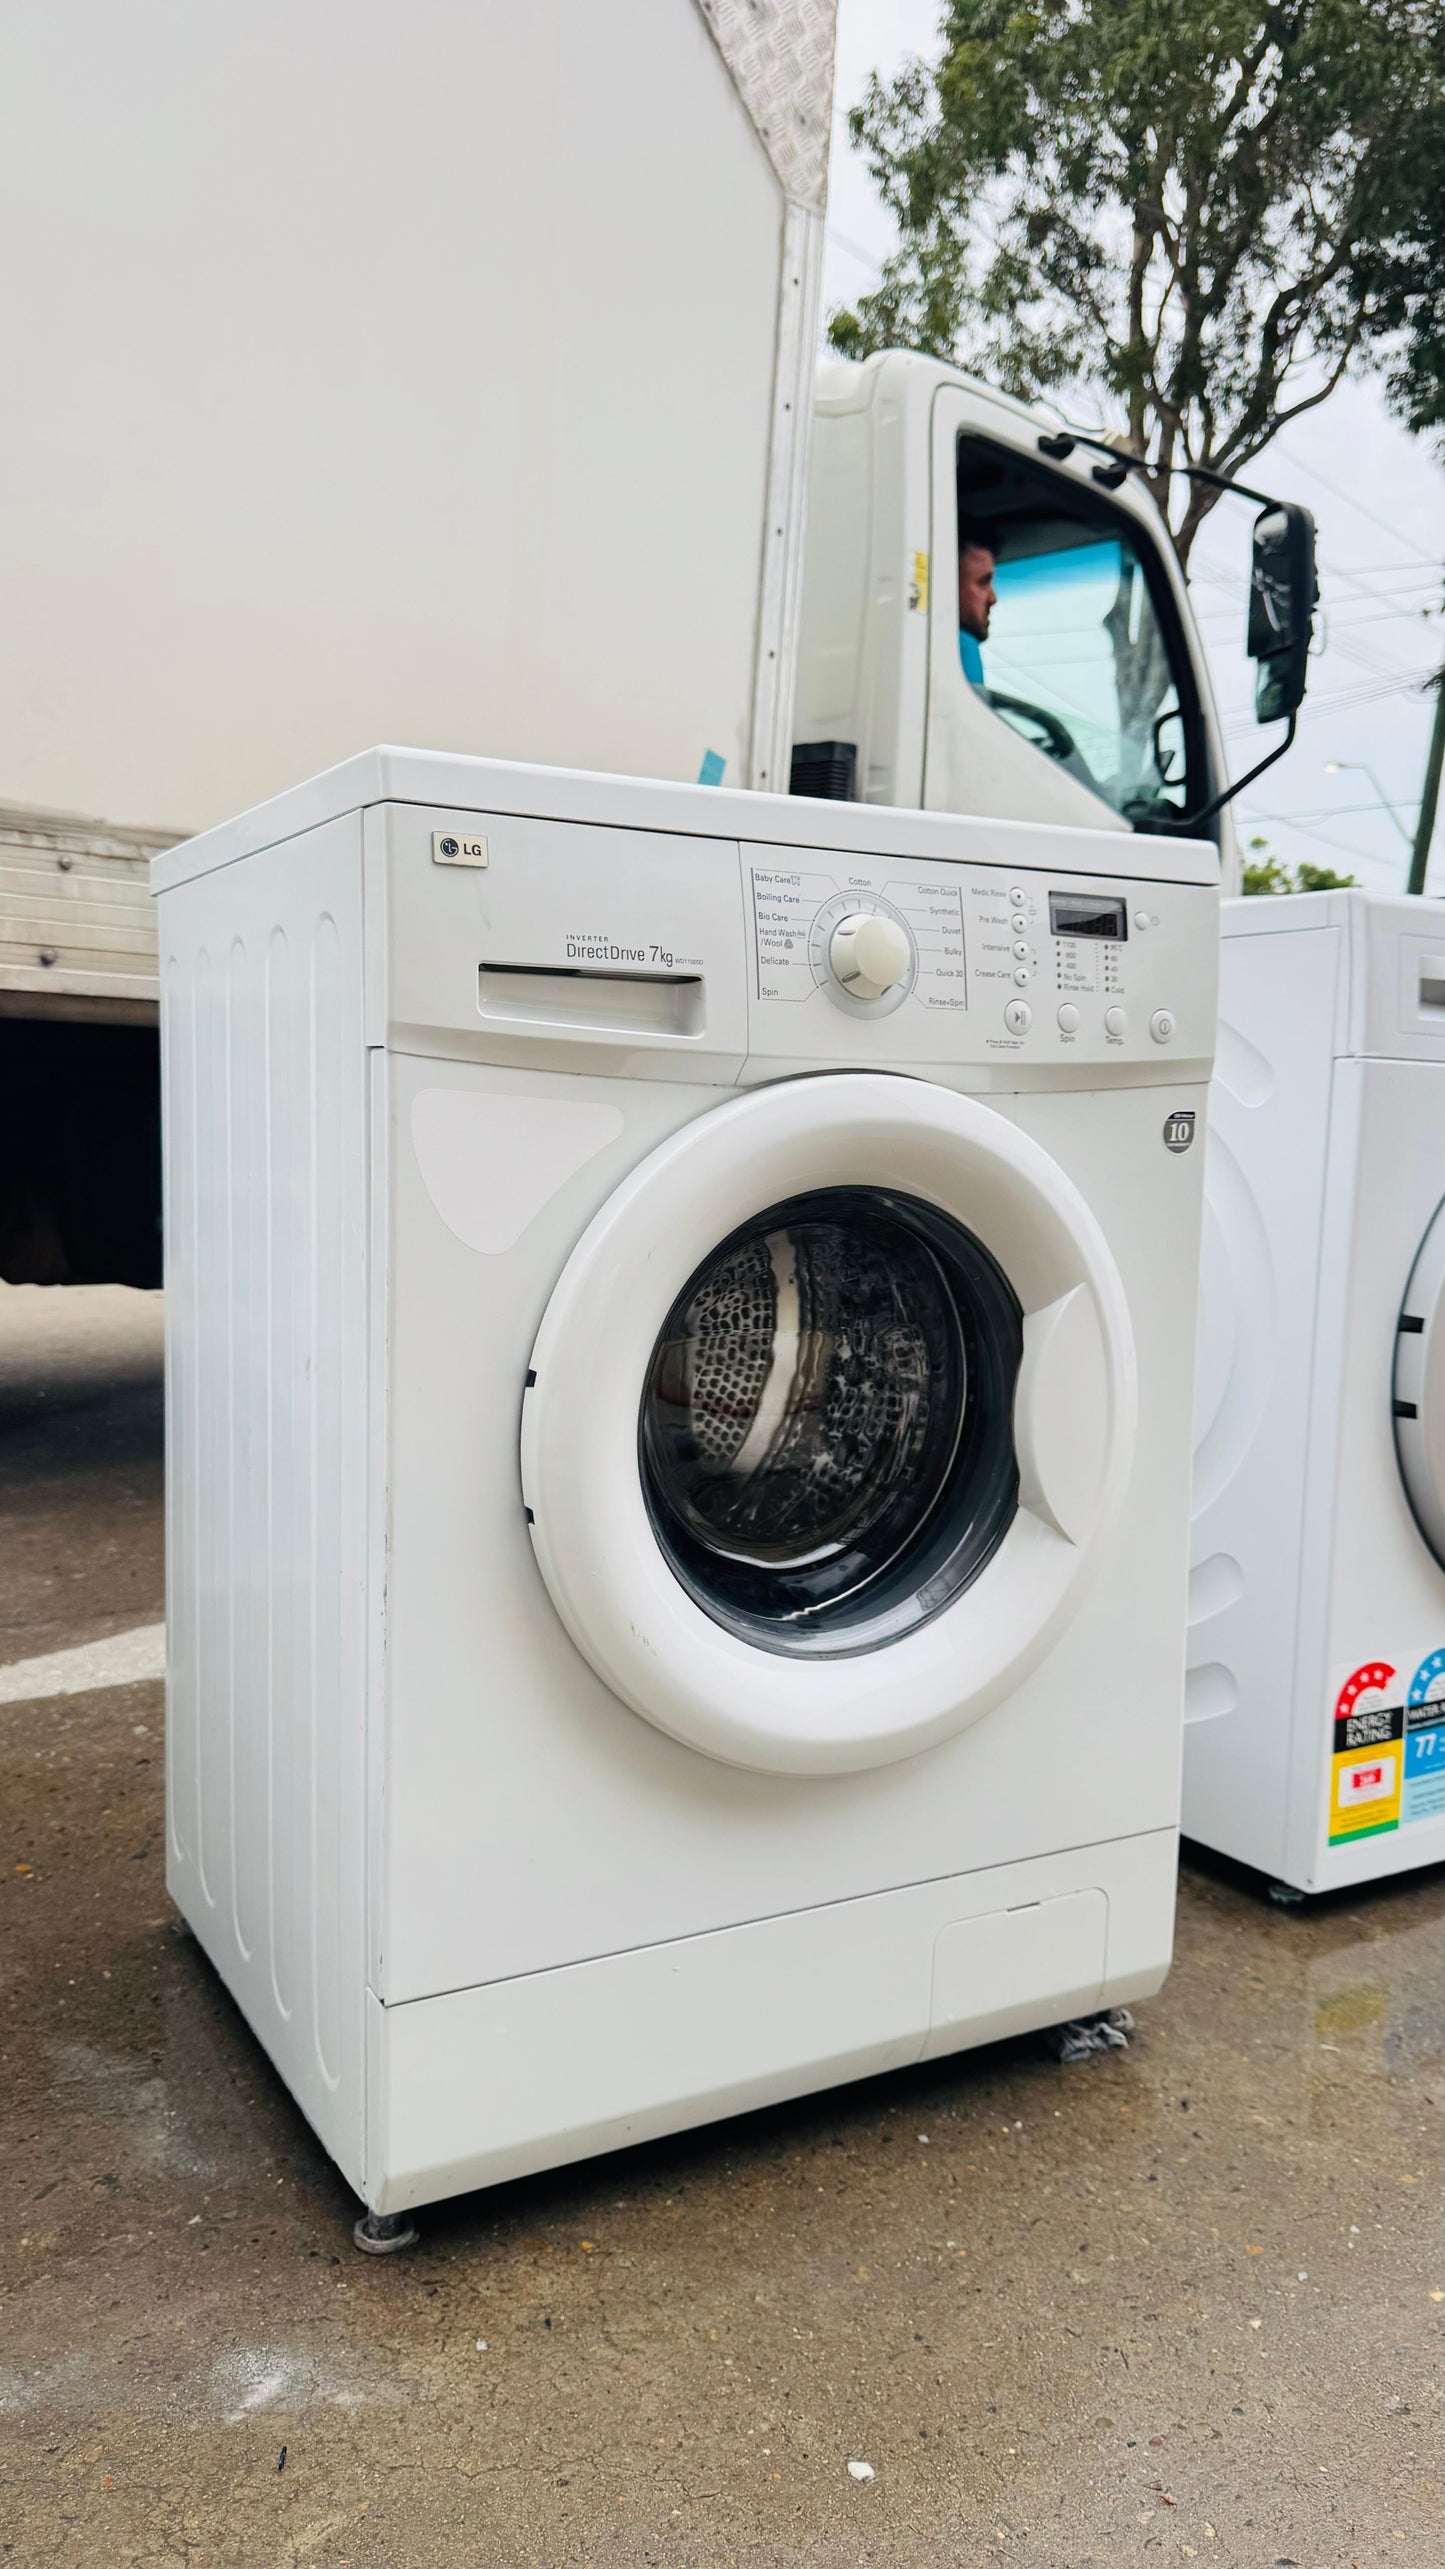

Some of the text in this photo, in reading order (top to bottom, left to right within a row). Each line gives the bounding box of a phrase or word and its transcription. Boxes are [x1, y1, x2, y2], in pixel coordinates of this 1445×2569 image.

[463, 843, 481, 856] LG
[755, 873, 791, 884] Baby Care
[848, 877, 871, 886] Cotton
[917, 886, 958, 896] Cotton Quick
[756, 892, 800, 903] Boiling Care
[758, 911, 788, 921] Bio Care
[929, 906, 959, 916] Synthetic
[759, 927, 797, 937] Hand Wash
[941, 926, 961, 935] Duvet
[566, 934, 609, 943] INVERTER
[760, 938, 782, 947] /Wool
[944, 947, 961, 957] Bulky
[760, 956, 789, 966] Delicate
[935, 968, 963, 978] Quick 30
[762, 987, 778, 996] Spin
[1060, 1034, 1075, 1043] Spin
[1170, 1122, 1189, 1142] 10
[1346, 1711, 1393, 1733] ENERGY
[1346, 1724, 1393, 1747] RATING
